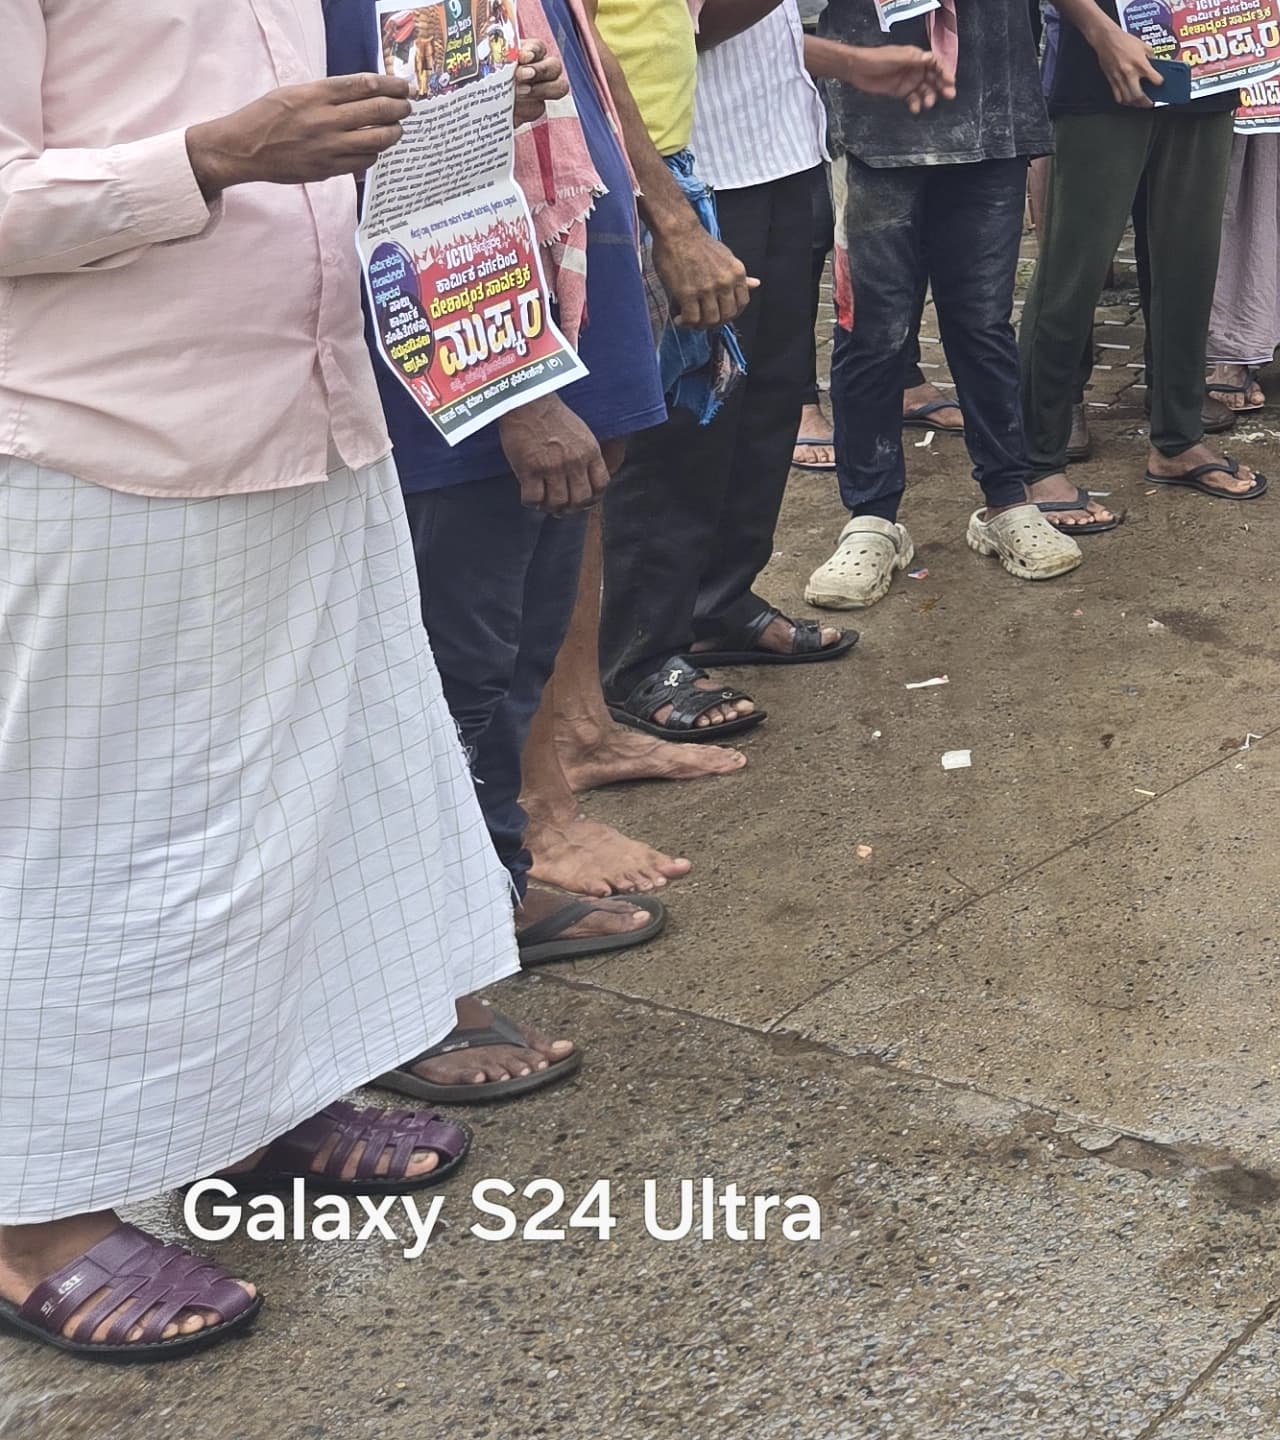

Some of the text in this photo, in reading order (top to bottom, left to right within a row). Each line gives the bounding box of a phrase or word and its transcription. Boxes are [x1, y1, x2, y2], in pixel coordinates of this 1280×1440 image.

[449, 0, 462, 18] 9
[1180, 21, 1280, 66] ಮುಷ್ಕರ
[445, 243, 473, 268] JCTU
[434, 288, 542, 375] ಮುಷ್ಕರ
